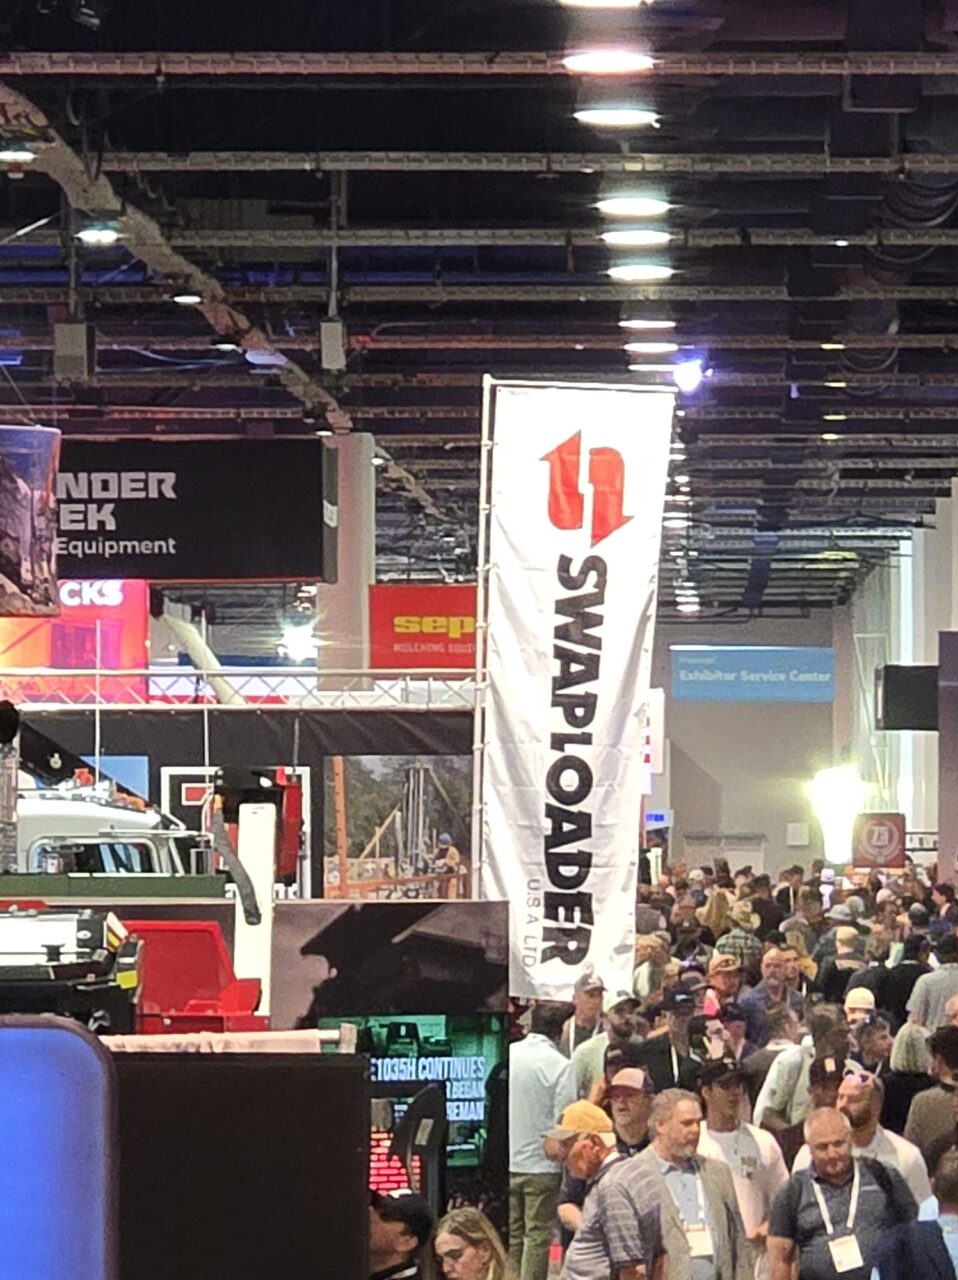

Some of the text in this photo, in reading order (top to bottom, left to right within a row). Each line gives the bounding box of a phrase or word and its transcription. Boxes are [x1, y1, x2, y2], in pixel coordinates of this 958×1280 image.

[57, 472, 177, 499] NDER
[60, 504, 117, 530] EK
[57, 537, 177, 558] Equipment
[60, 581, 124, 606] CKS
[393, 616, 476, 639] sep
[679, 669, 831, 683] Exhibitor Service Center
[540, 554, 608, 966] SWAPLOADER
[418, 1057, 485, 1080] CONTINUES
